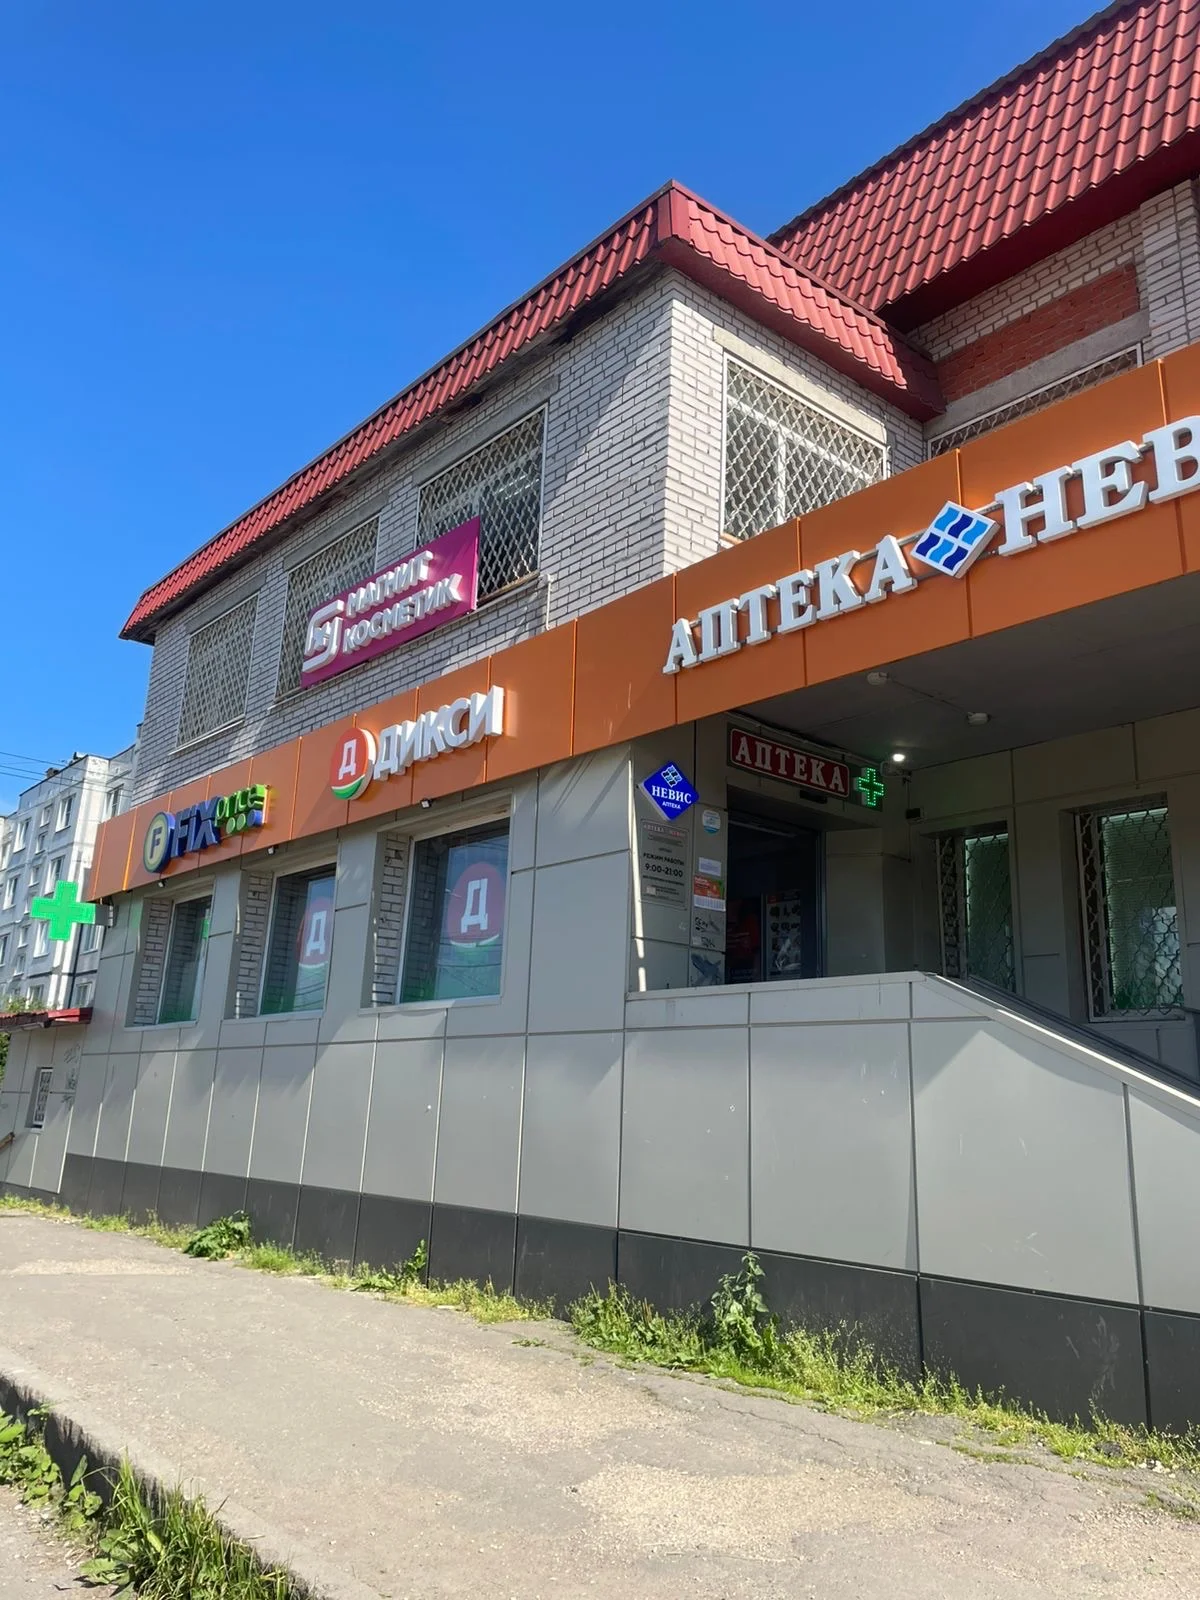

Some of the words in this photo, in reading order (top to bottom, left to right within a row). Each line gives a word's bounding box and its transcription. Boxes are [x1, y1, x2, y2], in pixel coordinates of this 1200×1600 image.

[662, 534, 919, 674] АПТЕКА
[995, 415, 1200, 556] НЕВ
[346, 550, 433, 618] МАГНИТ
[342, 573, 462, 653] КОСМЕТИК
[338, 739, 357, 780] Д
[373, 685, 504, 781] ДИКСИ
[735, 735, 846, 794] АПТЕКА
[651, 785, 692, 804] НЕВИС
[662, 801, 682, 810] АПТЕКА
[645, 862, 684, 878] 9:00-21:00
[305, 911, 327, 957] Д
[461, 878, 489, 933] Д
